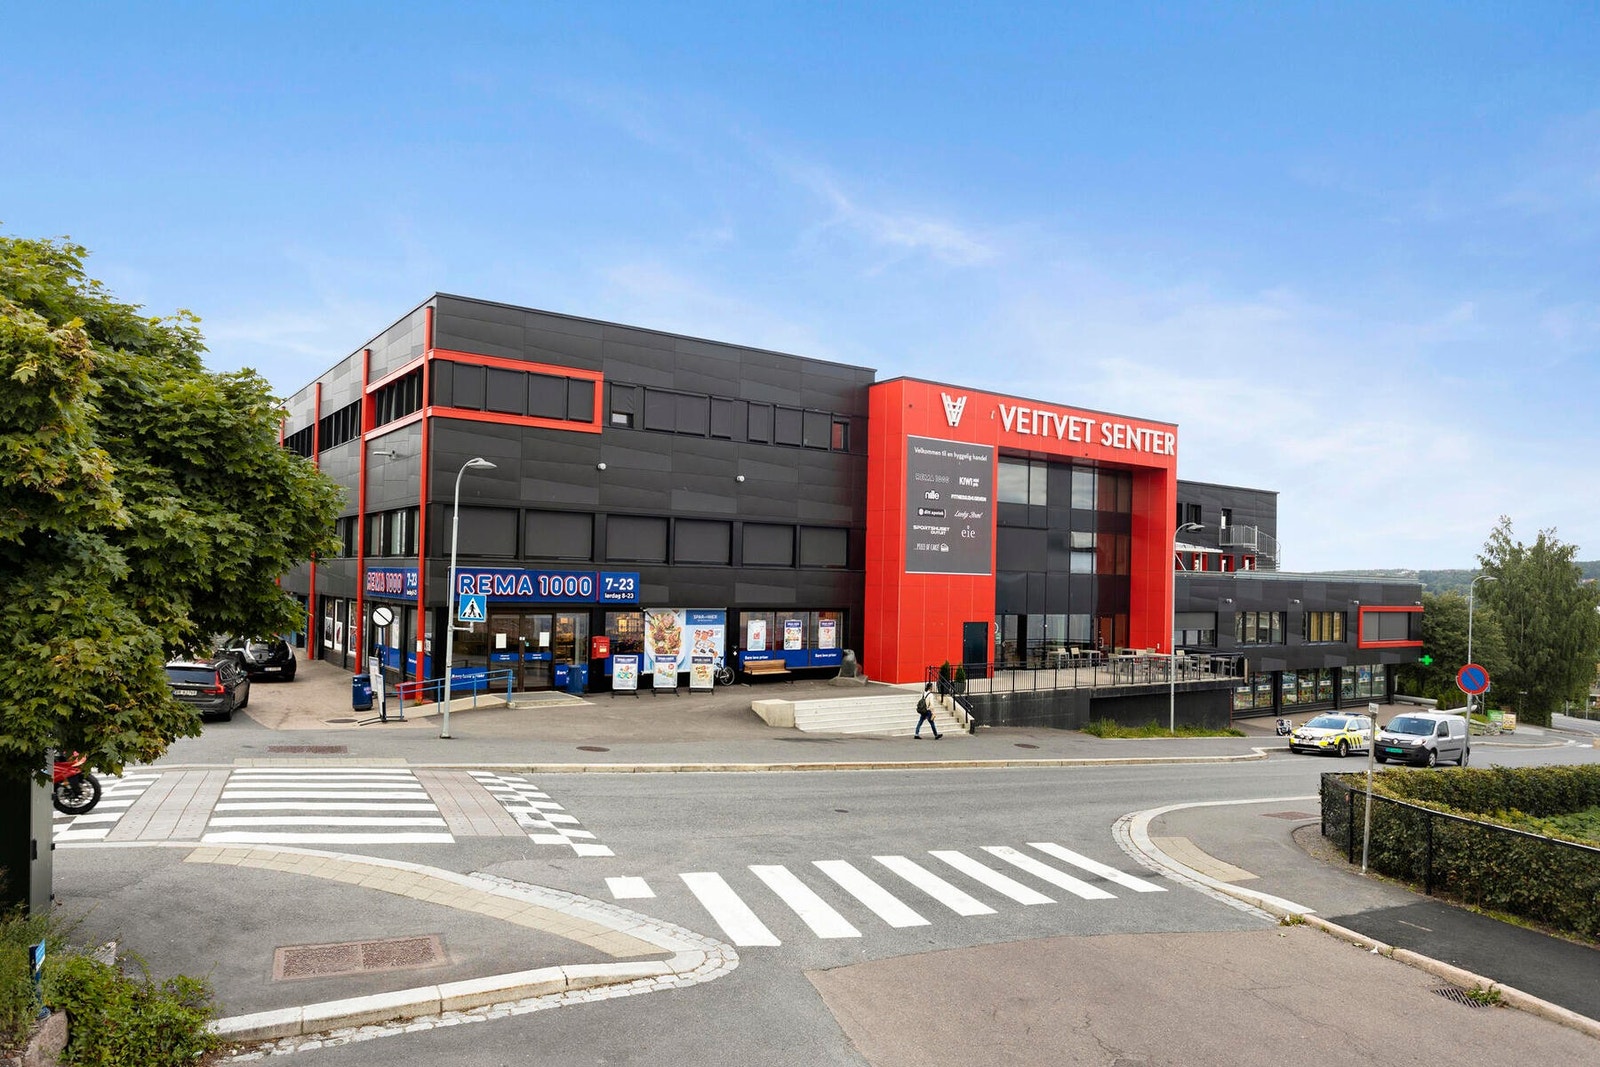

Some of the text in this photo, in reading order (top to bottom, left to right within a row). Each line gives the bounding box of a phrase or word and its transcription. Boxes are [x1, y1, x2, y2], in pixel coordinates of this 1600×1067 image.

[999, 404, 1175, 456] VEITVET SENTER
[914, 446, 941, 456] Velkommen
[959, 476, 973, 486] KIWI
[961, 525, 976, 538] eie
[367, 572, 403, 594] REMA 1000
[457, 574, 592, 597] REMA 1000
[605, 577, 634, 591] 7-23
[621, 592, 635, 600] 8-23
